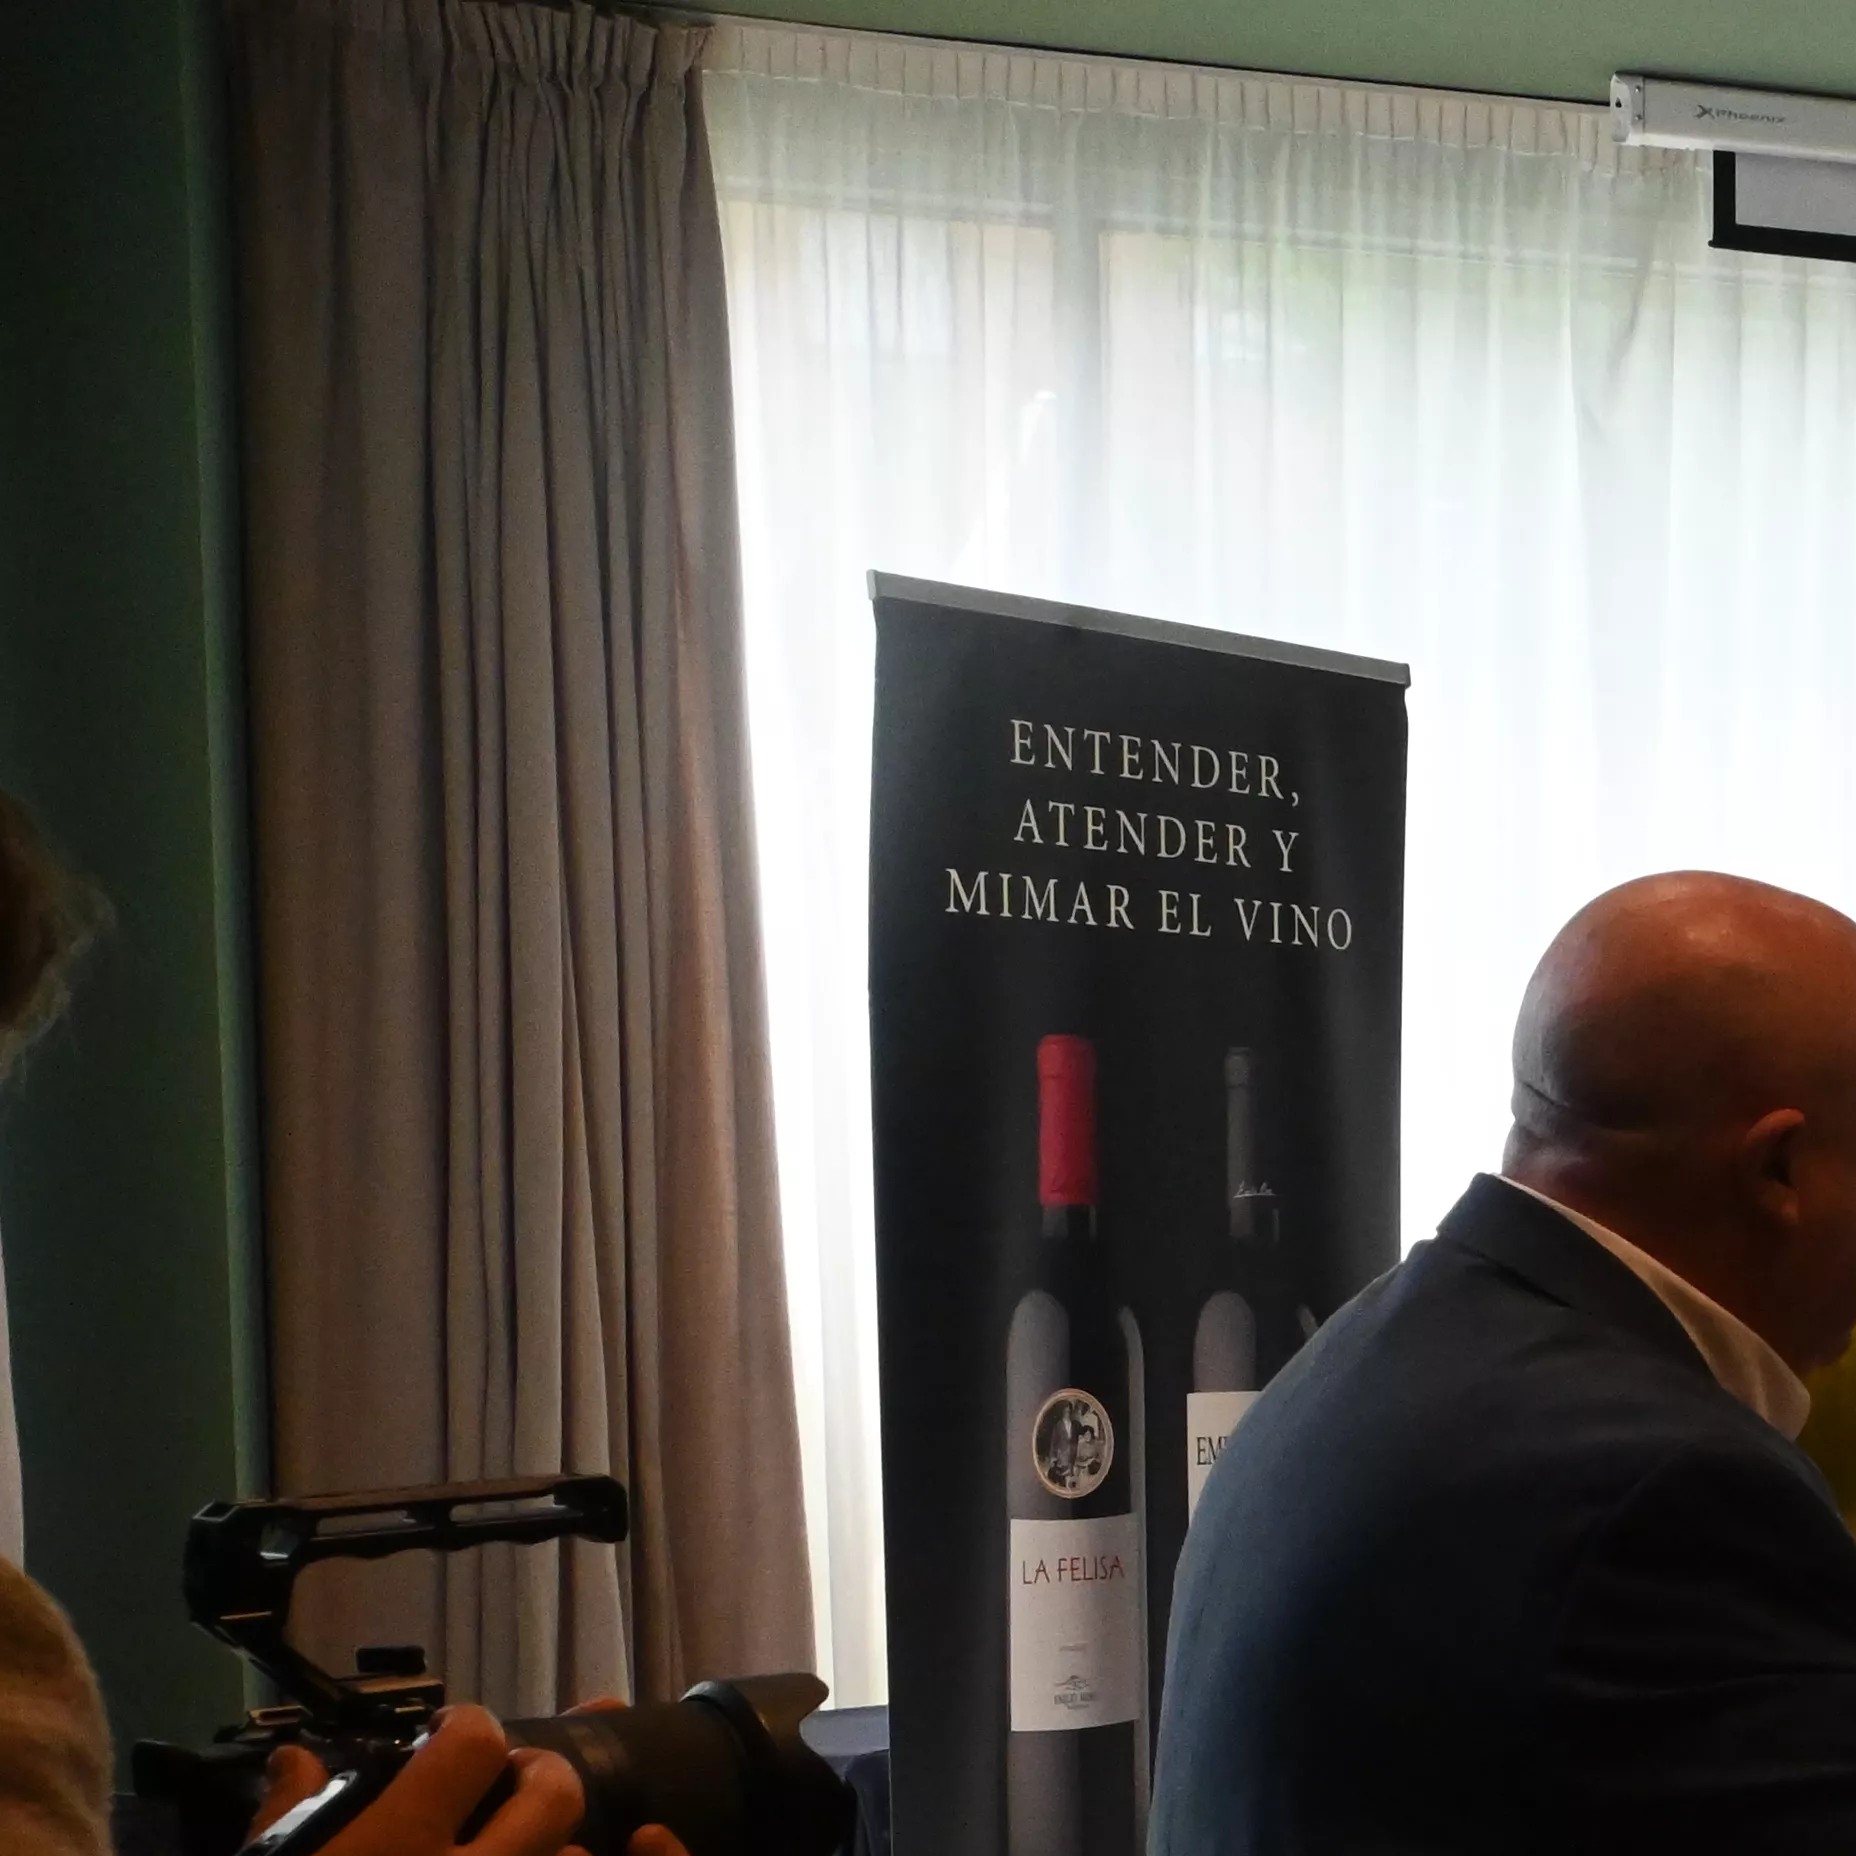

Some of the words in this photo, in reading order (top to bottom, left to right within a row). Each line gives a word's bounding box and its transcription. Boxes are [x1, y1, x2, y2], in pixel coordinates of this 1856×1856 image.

[1009, 718, 1300, 807] ENTENDER,
[1013, 798, 1252, 869] ATENDER
[1271, 829, 1300, 873] Y
[944, 867, 1135, 930] MIMAR
[1157, 889, 1213, 938] EL
[1233, 898, 1353, 951] VINO
[1022, 1559, 1051, 1585] LA
[1057, 1555, 1126, 1582] FELISA
